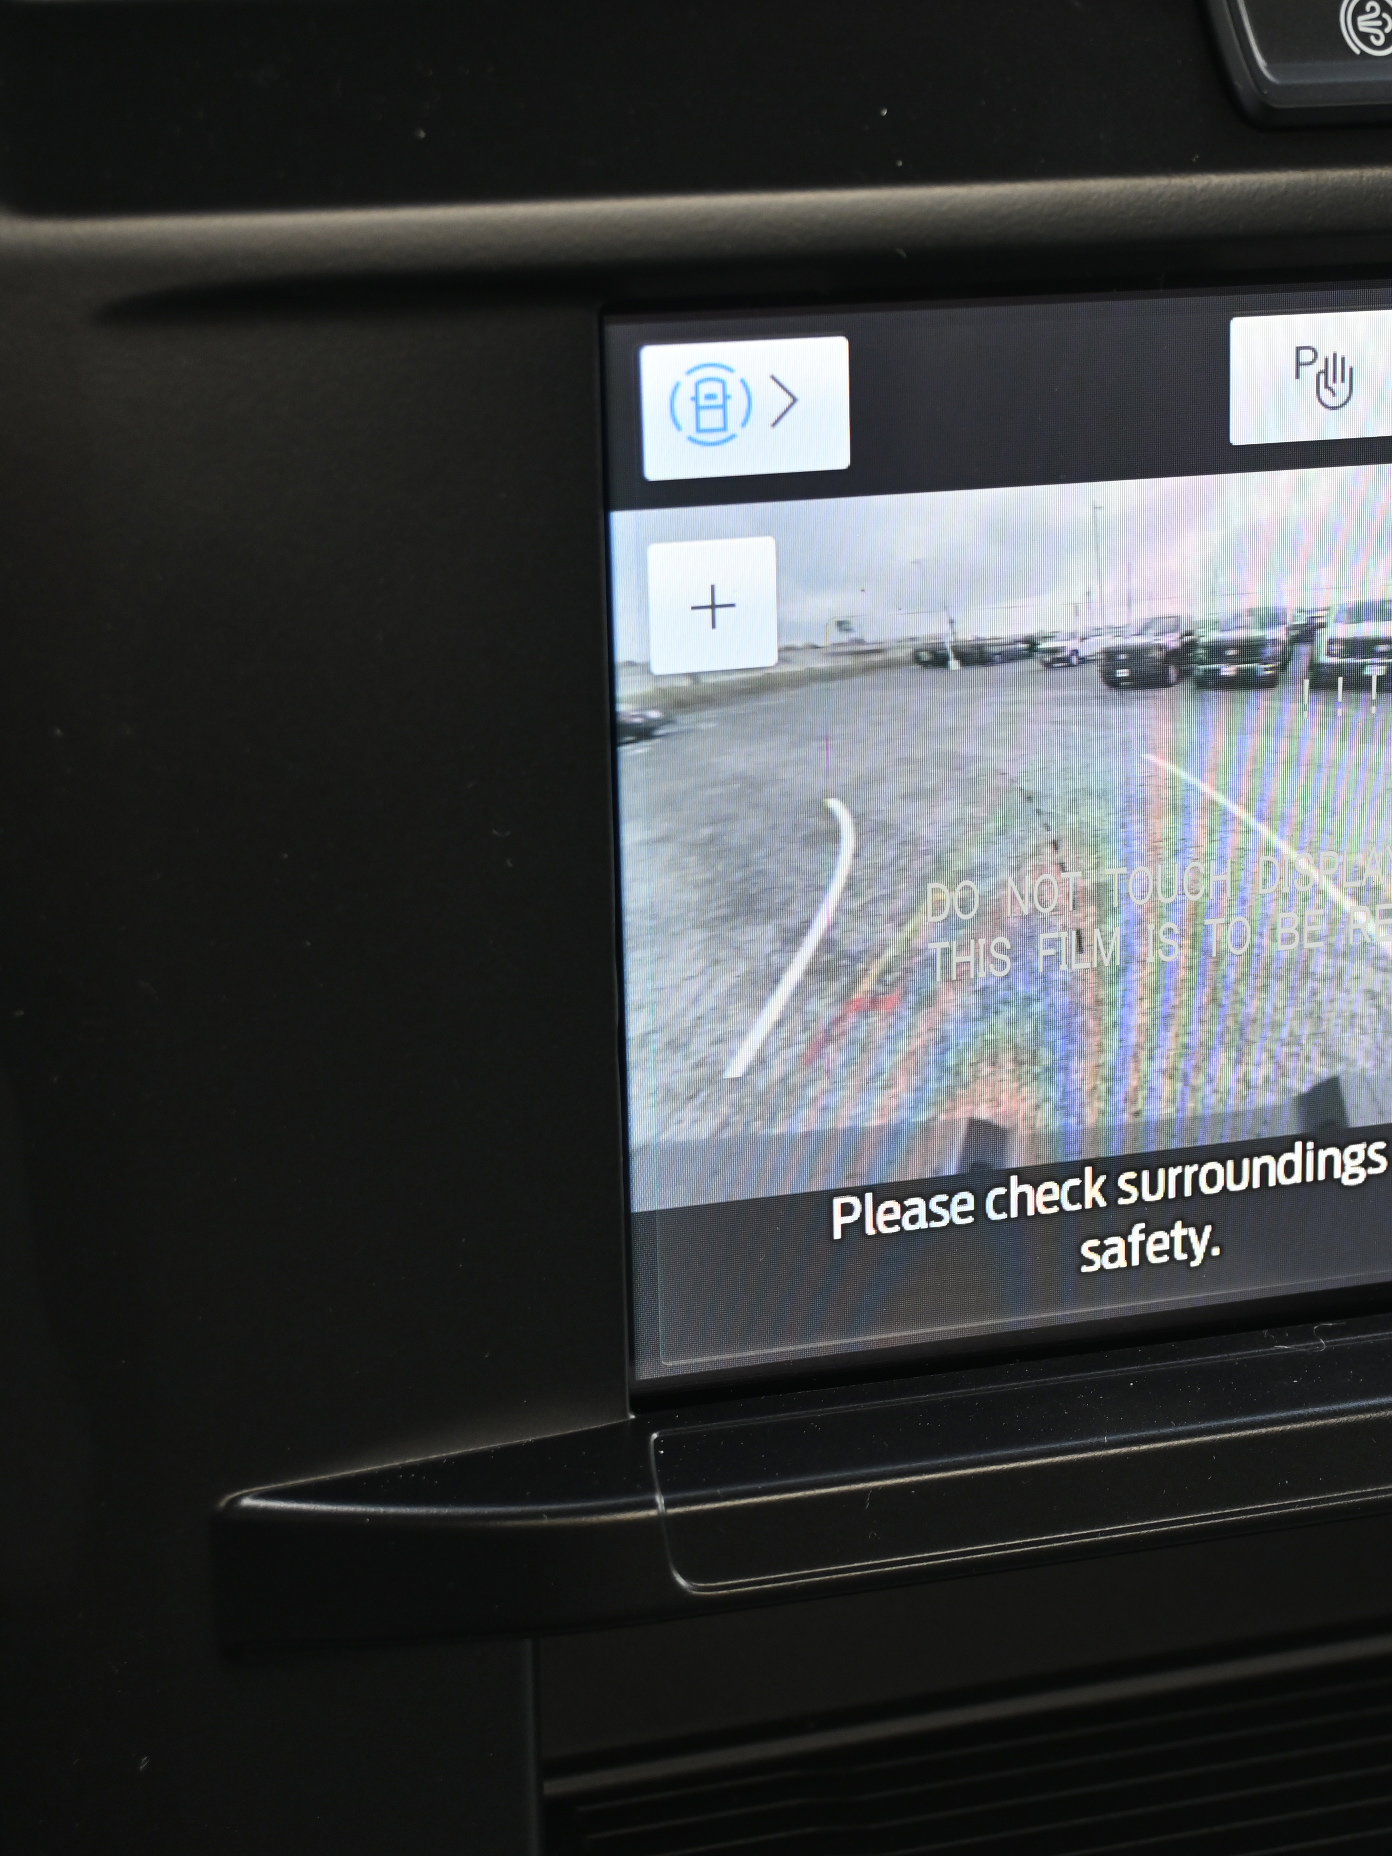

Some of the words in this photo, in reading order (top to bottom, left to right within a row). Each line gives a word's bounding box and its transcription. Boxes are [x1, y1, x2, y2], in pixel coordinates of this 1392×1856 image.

[926, 880, 979, 923] DO
[1007, 871, 1083, 917] NOT
[1107, 858, 1231, 908] TOUCH
[928, 936, 1011, 982] THIS
[1038, 926, 1121, 974] FILM
[1146, 923, 1181, 964] IS
[1204, 915, 1252, 958] TO
[1276, 908, 1324, 952] BE
[832, 1190, 975, 1240] Please
[984, 1165, 1107, 1221] check
[1117, 1138, 1389, 1205] surroundings
[1080, 1219, 1222, 1273] safety.
